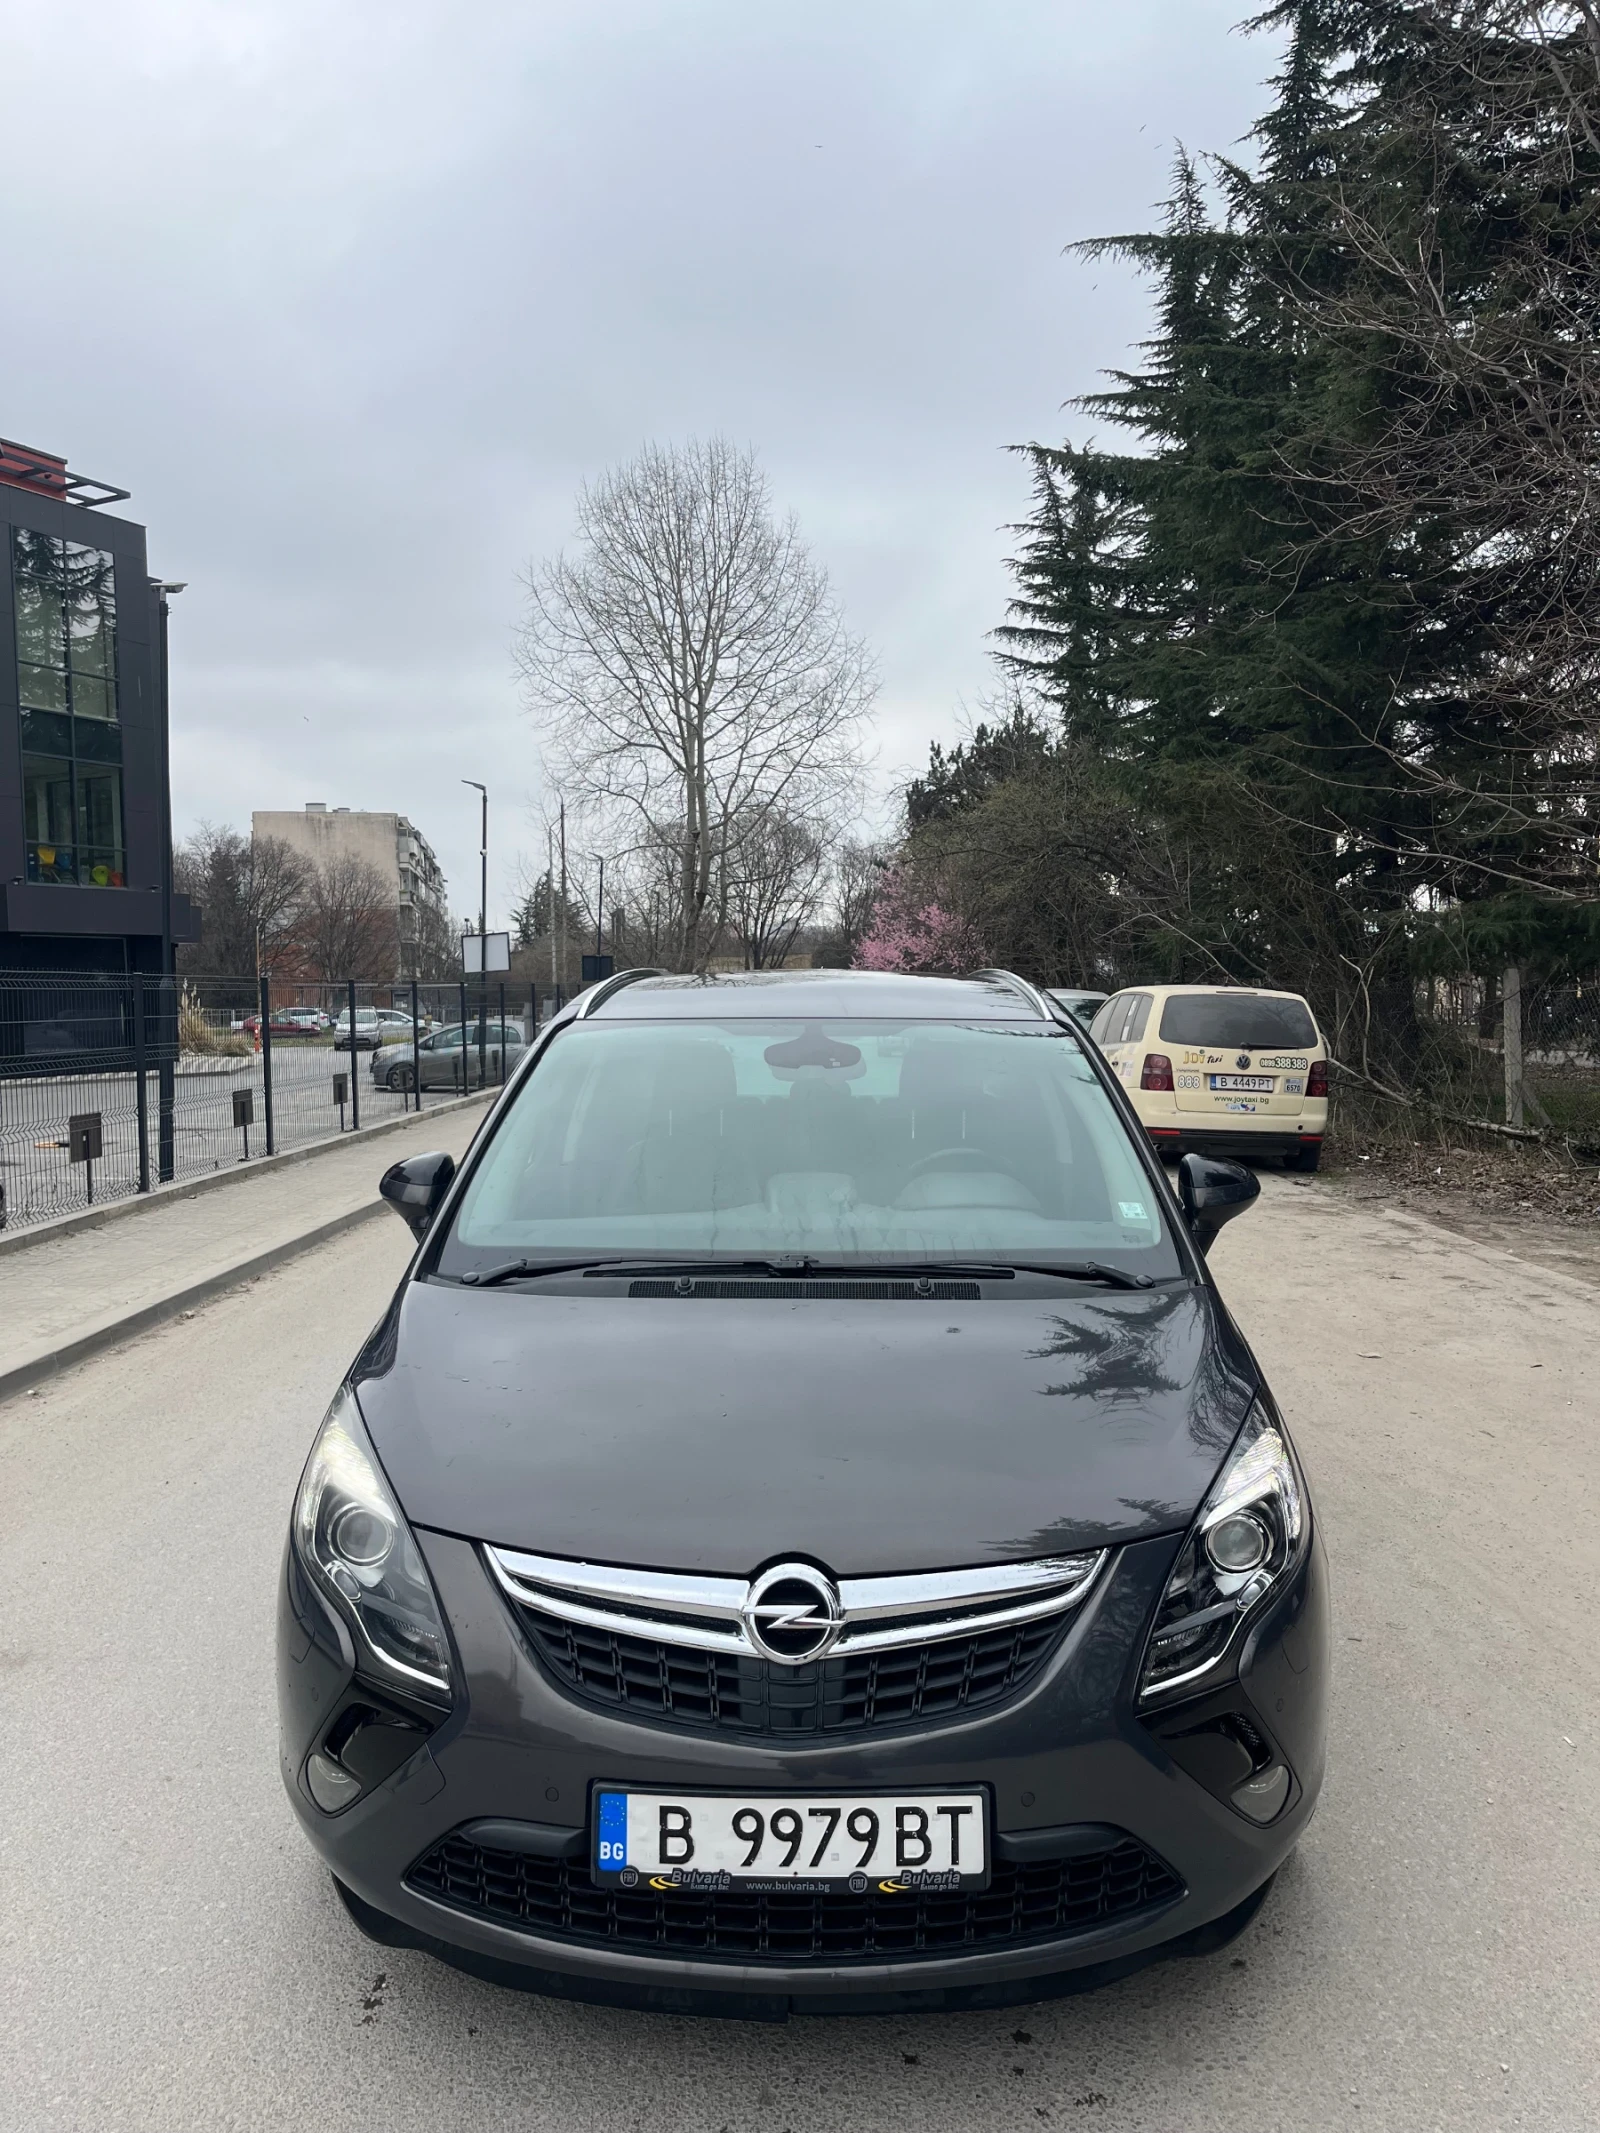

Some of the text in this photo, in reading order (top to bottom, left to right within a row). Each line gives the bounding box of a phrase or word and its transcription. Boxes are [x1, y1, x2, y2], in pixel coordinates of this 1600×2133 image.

[1207, 1055, 1223, 1064] taxi
[1178, 1075, 1200, 1089] 888
[1220, 1077, 1228, 1087] B
[1213, 1095, 1270, 1105] www.joytaxi.bg
[658, 1805, 973, 1868] B 9979 BT
[600, 1841, 624, 1860] BG
[623, 1873, 635, 1883] FIAT
[671, 1869, 731, 1885] Bulvaria
[853, 1878, 865, 1889] FIAT
[901, 1869, 961, 1885] Bulvaria
[746, 1880, 831, 1893] www.bulvaria.bg
